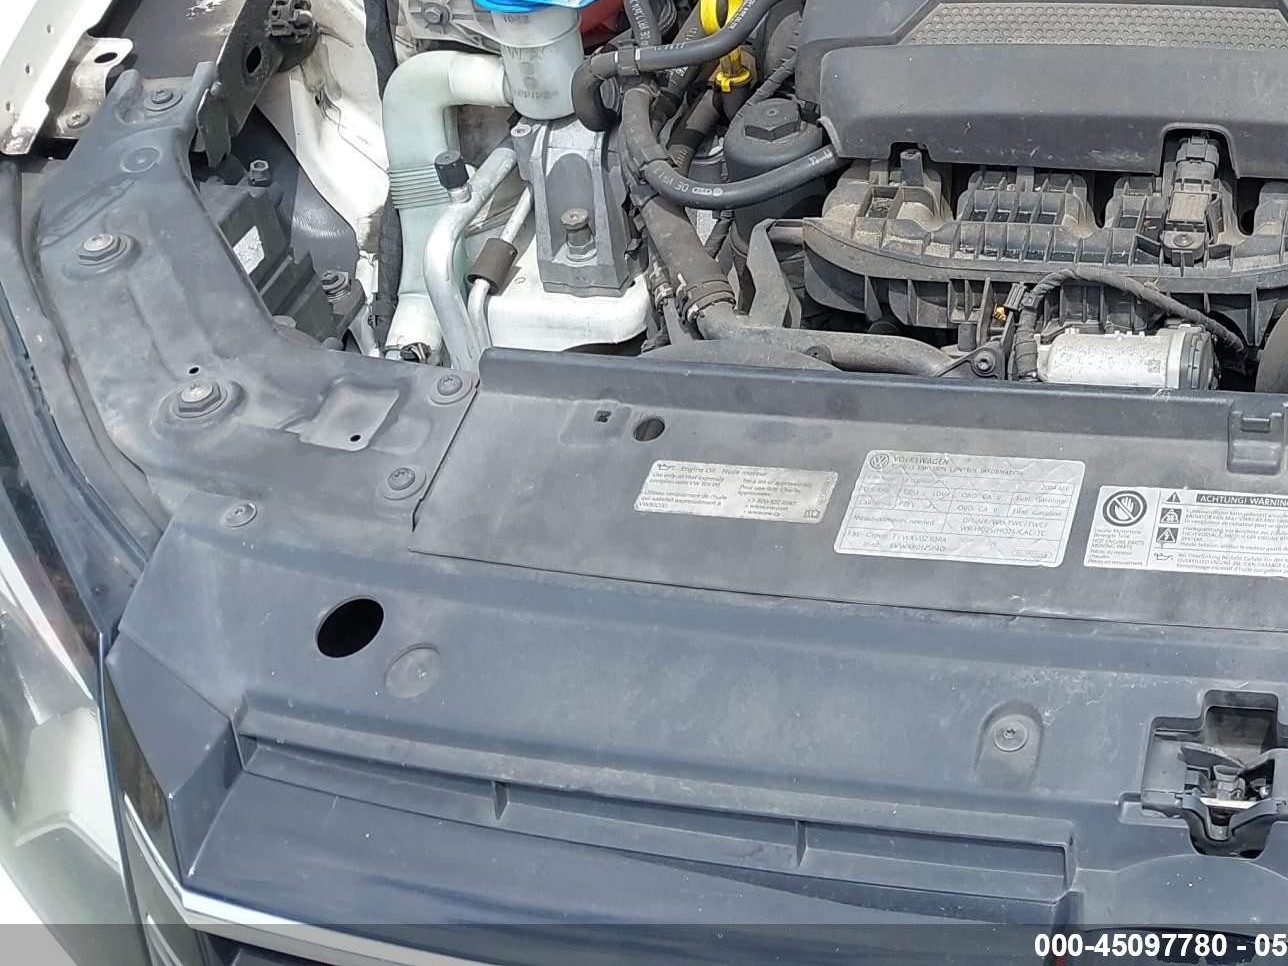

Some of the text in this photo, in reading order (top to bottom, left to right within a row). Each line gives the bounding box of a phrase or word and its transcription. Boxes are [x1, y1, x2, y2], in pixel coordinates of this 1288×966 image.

[893, 456, 949, 466] VOLKSWAGEN
[680, 465, 705, 474] Engine
[721, 468, 740, 476] Huile
[949, 466, 978, 474] CONTROL
[979, 467, 1024, 476] INFORMATION
[1035, 496, 1067, 505] Gasoline
[1200, 494, 1248, 505] ACHTUNG!
[1031, 509, 1063, 517] Gasoline
[1185, 513, 1212, 521] RADIATOR
